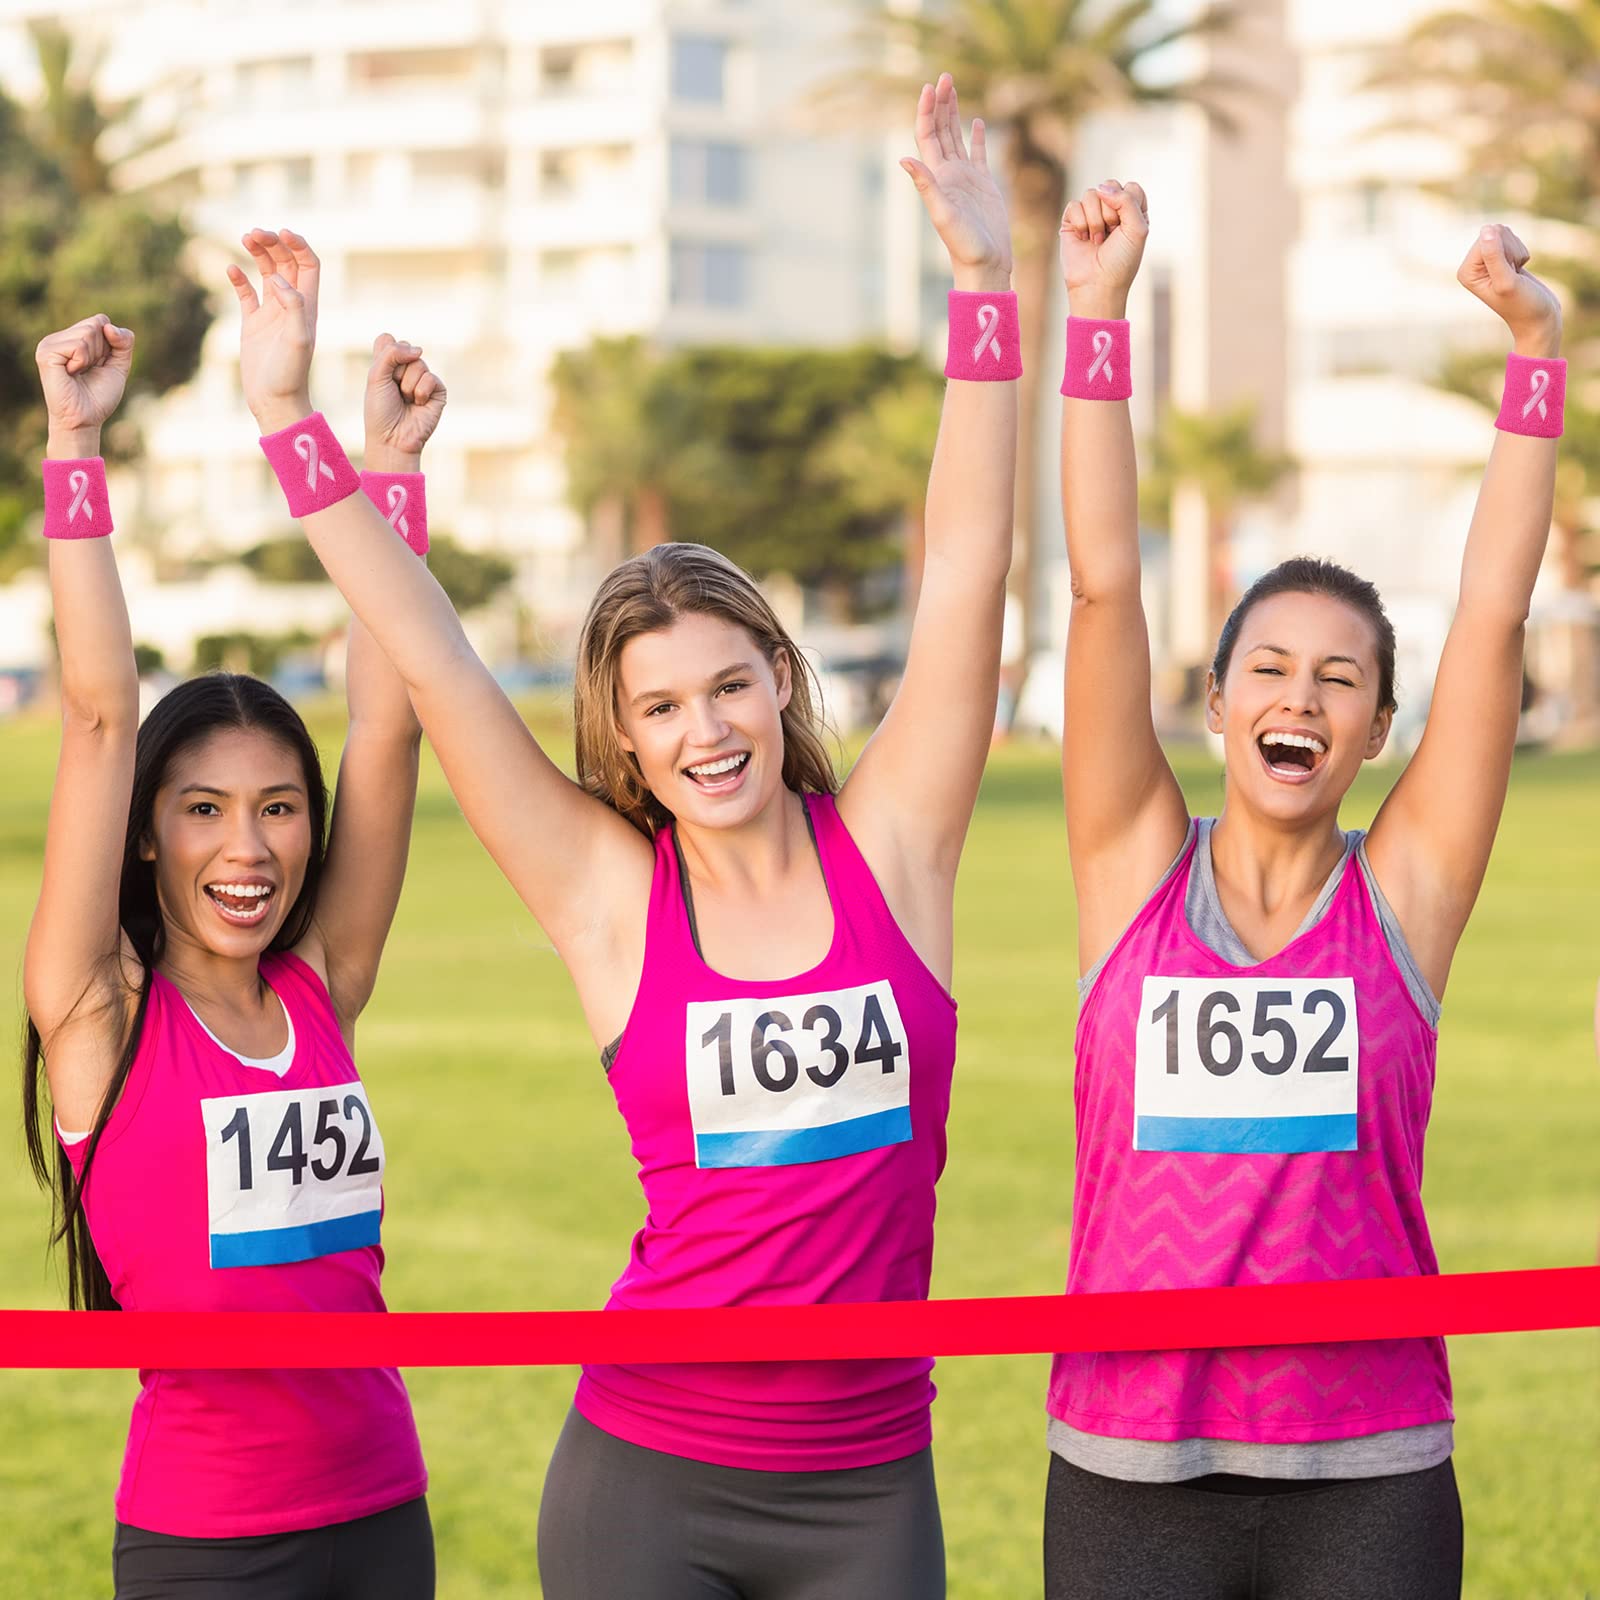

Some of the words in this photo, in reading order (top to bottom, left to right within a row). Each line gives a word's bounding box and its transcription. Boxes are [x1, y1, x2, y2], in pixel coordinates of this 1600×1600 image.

[700, 994, 903, 1096] 1634
[1151, 990, 1350, 1077] 1652
[220, 1094, 380, 1191] 1452
